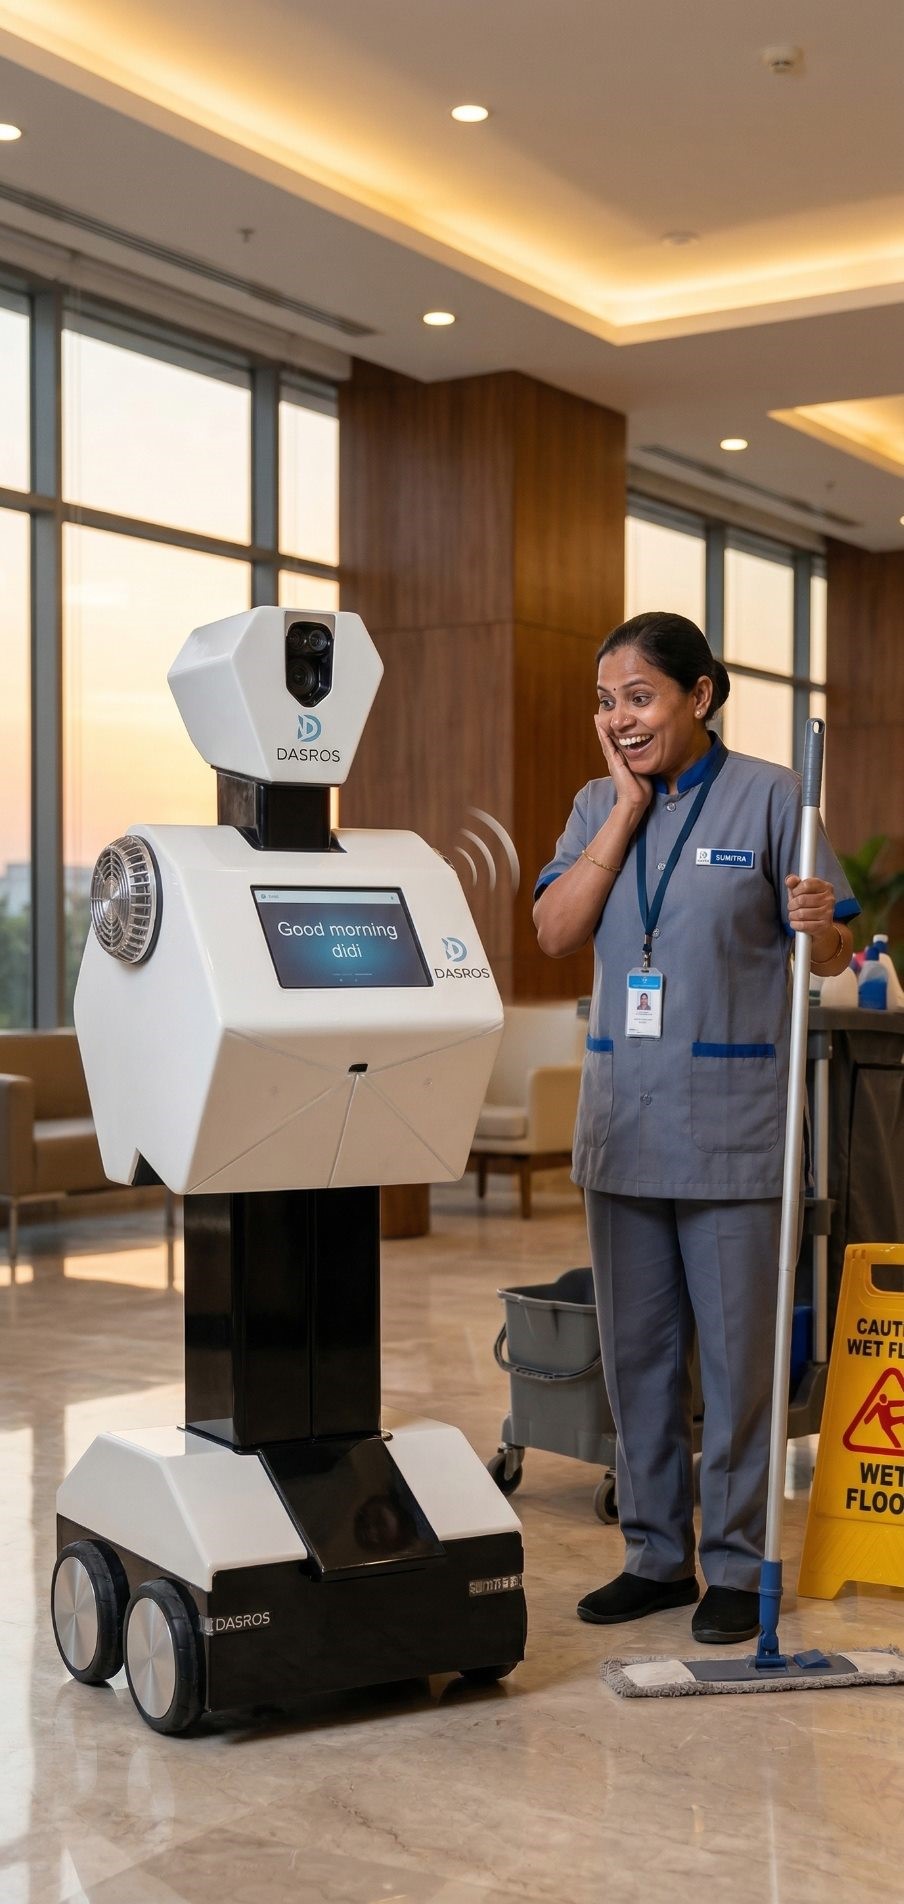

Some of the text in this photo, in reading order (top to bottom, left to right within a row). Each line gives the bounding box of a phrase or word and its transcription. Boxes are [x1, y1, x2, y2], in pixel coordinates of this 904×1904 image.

[277, 747, 341, 763] DASROS
[715, 854, 747, 863] SUMITRA
[277, 921, 398, 940] Good morning
[332, 943, 363, 958] didi
[434, 967, 490, 979] DASROS
[856, 1317, 904, 1338] CAUT
[847, 1338, 884, 1358] WET
[860, 1462, 904, 1488] WET
[845, 1487, 904, 1515] FLOO
[215, 1611, 271, 1631] DASROS
